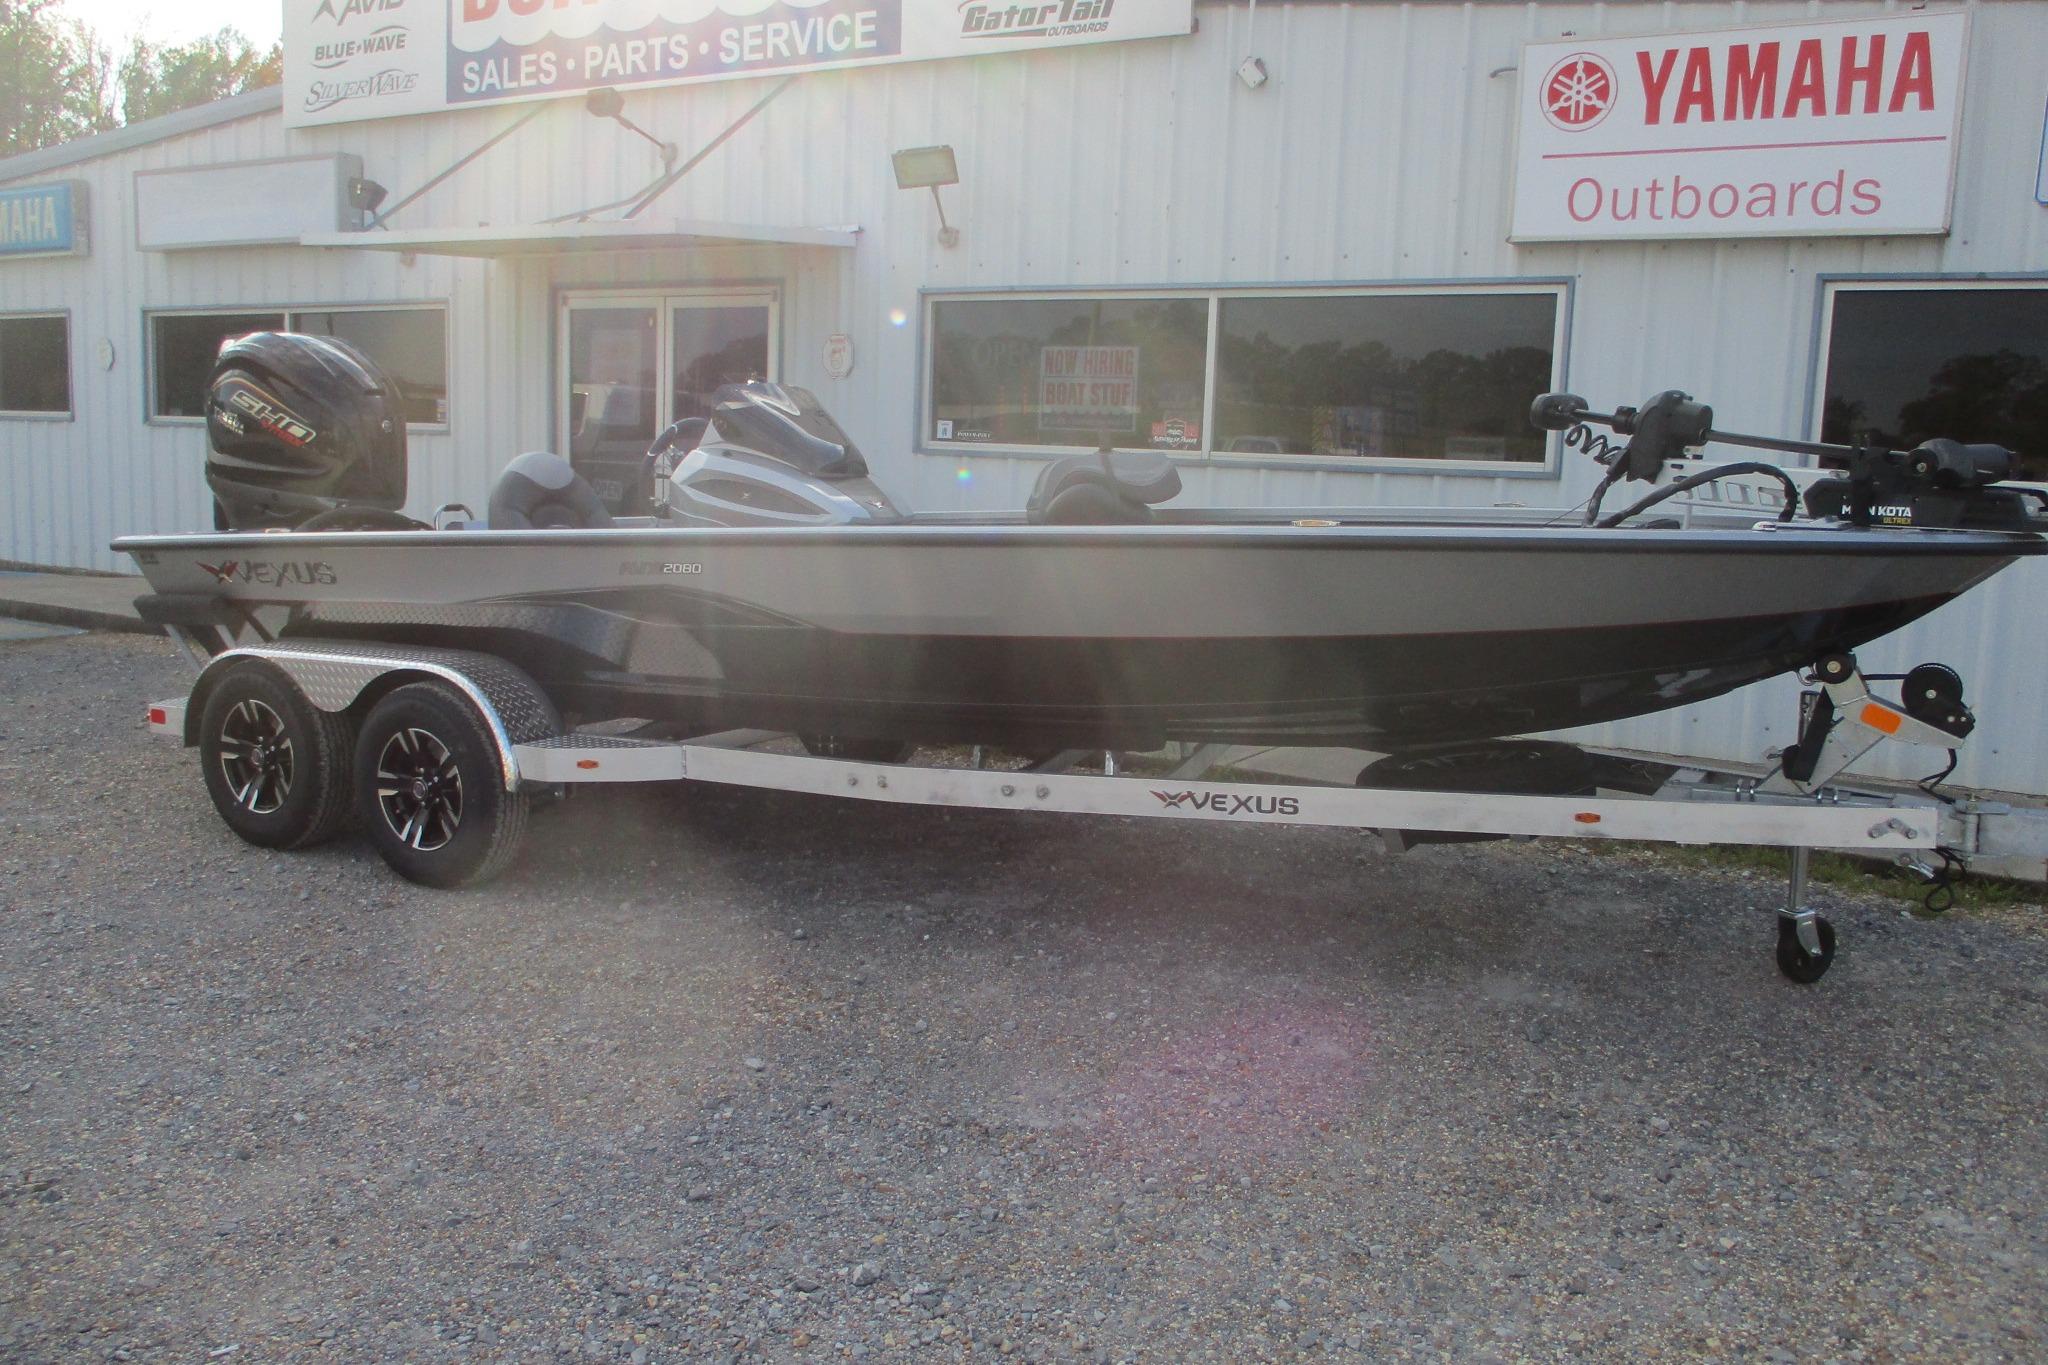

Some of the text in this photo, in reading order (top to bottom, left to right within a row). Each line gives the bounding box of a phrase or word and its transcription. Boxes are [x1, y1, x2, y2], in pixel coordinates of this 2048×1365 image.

[1047, 21, 1109, 37] OUTBOARDS
[314, 34, 407, 61] BLUE WAVE
[463, 10, 877, 94] SALES PARTS SERVICE
[1636, 31, 1935, 126] YAMAHA
[1567, 169, 1882, 223] Outboards
[1841, 504, 1912, 517] MN KOTA
[235, 560, 337, 587] VEXUS
[663, 563, 702, 574] 2080
[1187, 791, 1300, 815] VEXUS
